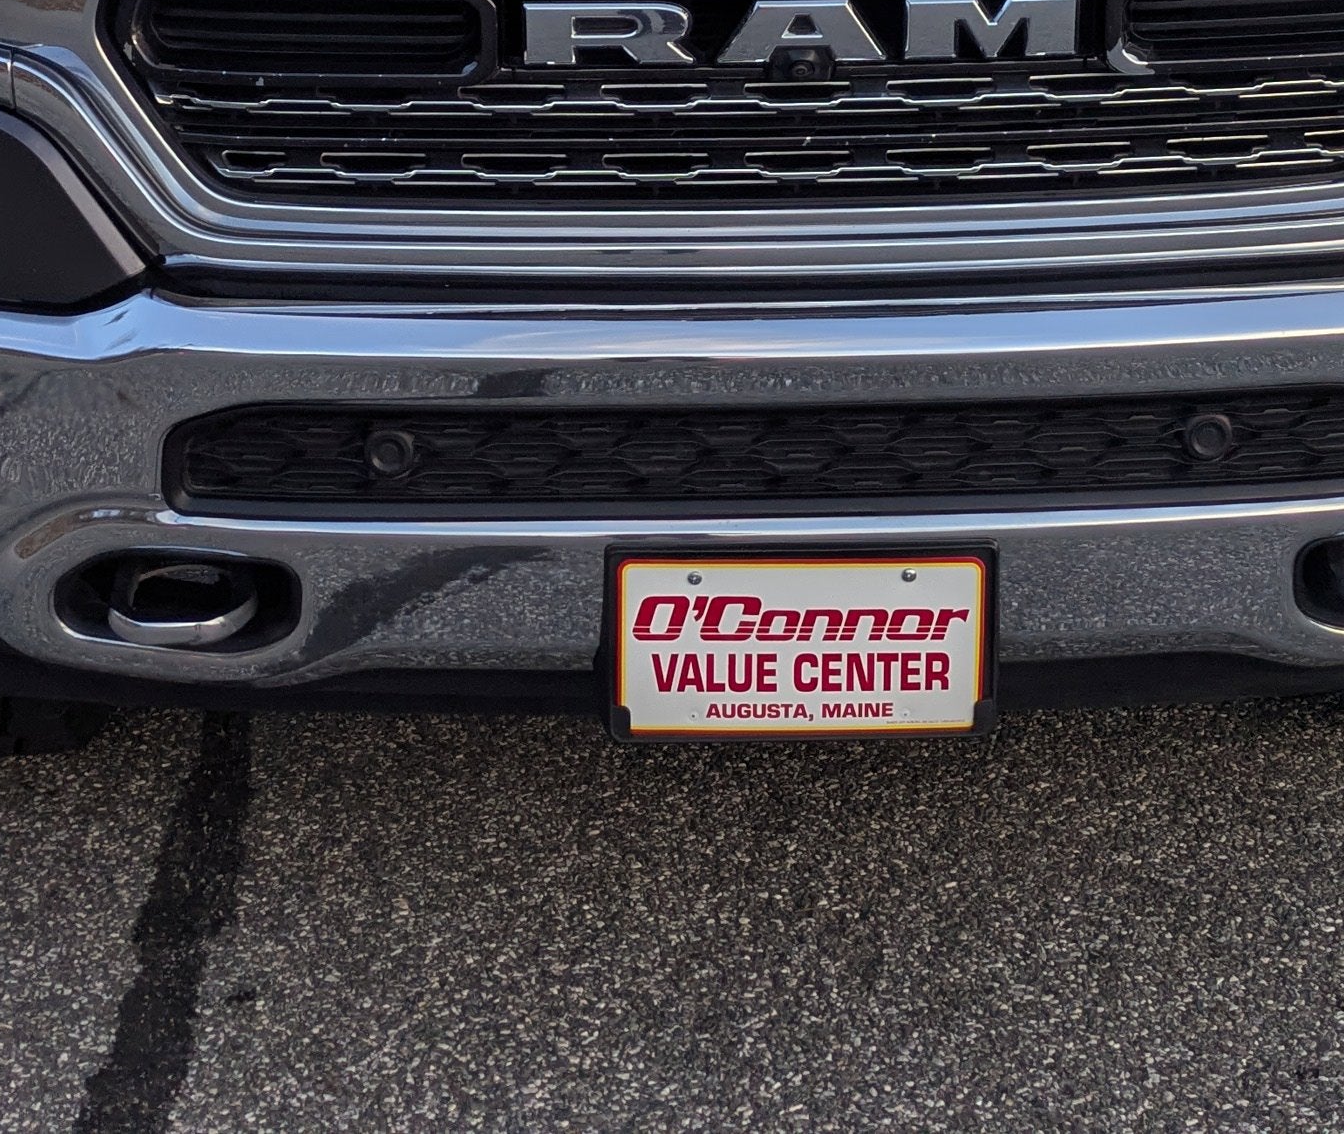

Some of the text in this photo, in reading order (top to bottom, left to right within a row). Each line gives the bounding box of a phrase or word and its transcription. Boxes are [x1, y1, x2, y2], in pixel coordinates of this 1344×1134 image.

[632, 595, 970, 642] O'Connor
[651, 652, 950, 692] VALUE CENTER
[706, 702, 894, 721] AUGUSTA, MAINE
